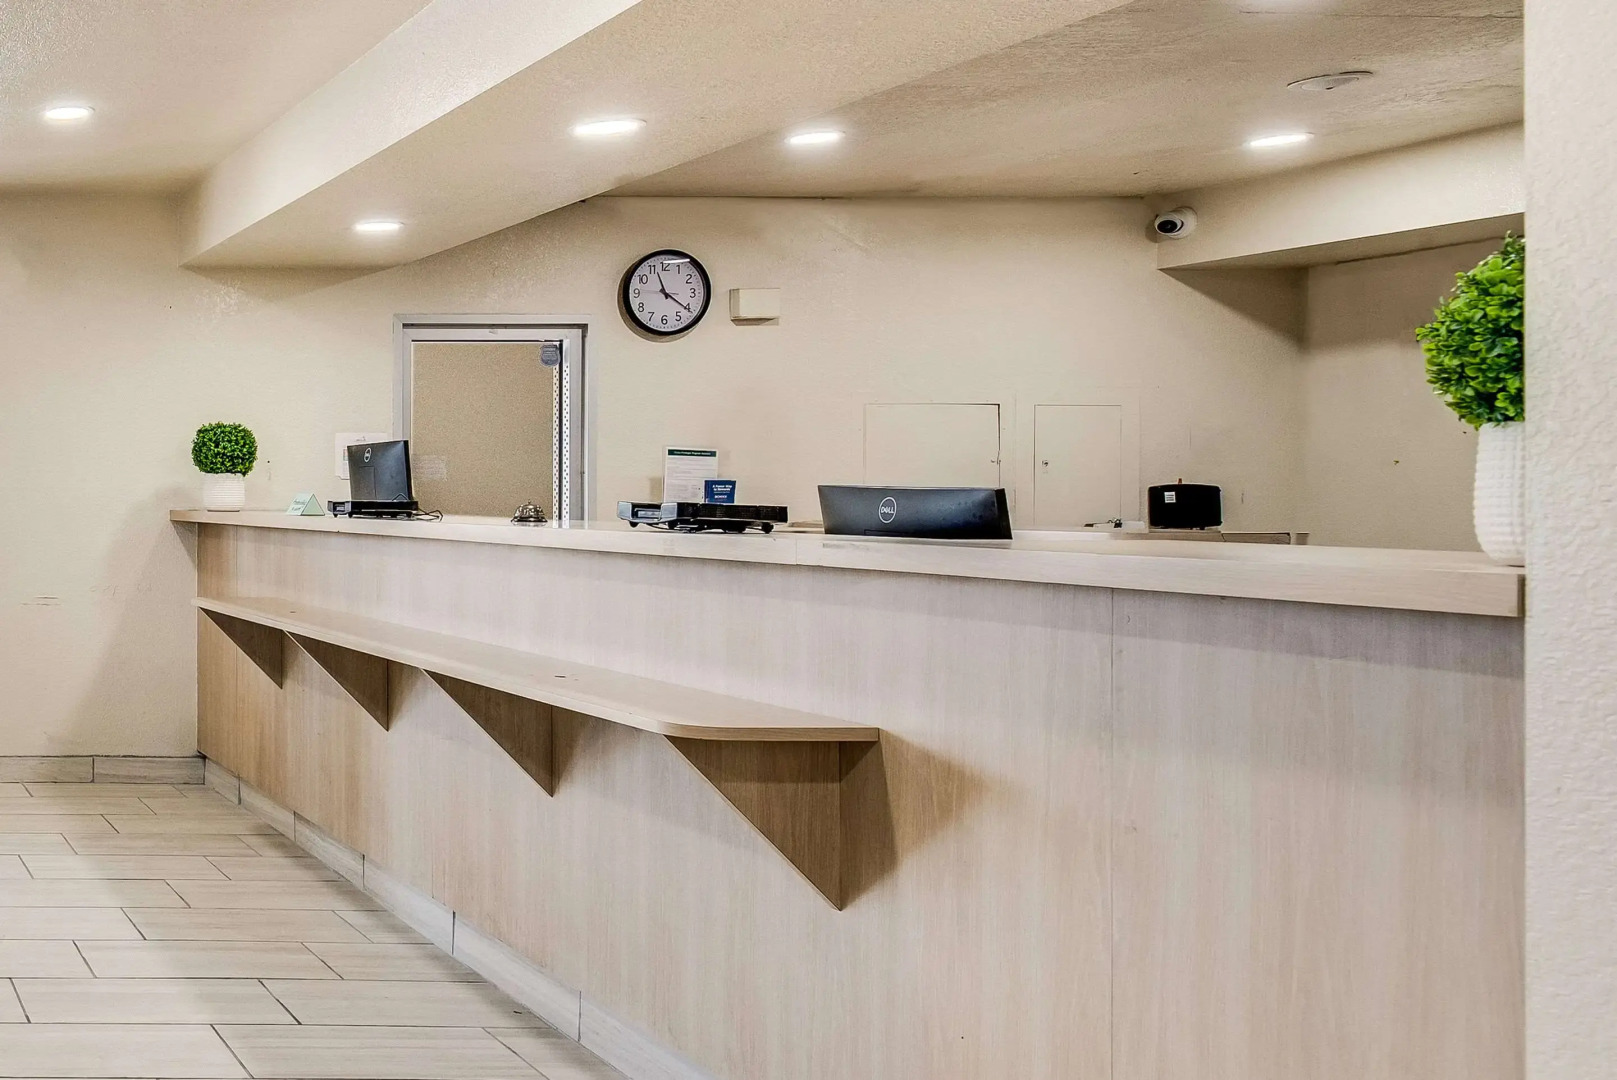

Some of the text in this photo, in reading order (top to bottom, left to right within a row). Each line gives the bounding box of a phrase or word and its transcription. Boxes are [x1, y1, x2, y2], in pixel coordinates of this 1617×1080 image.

[648, 265, 656, 274] 11
[660, 262, 670, 271] 12
[677, 265, 681, 274] 1
[638, 274, 648, 284] 10
[686, 274, 692, 284] 2
[634, 288, 640, 298] 9
[690, 288, 696, 298] 3
[638, 302, 644, 312] 8
[684, 303, 691, 312] 4
[648, 312, 655, 321] 7
[661, 315, 668, 325] 6
[675, 311, 681, 321] 5
